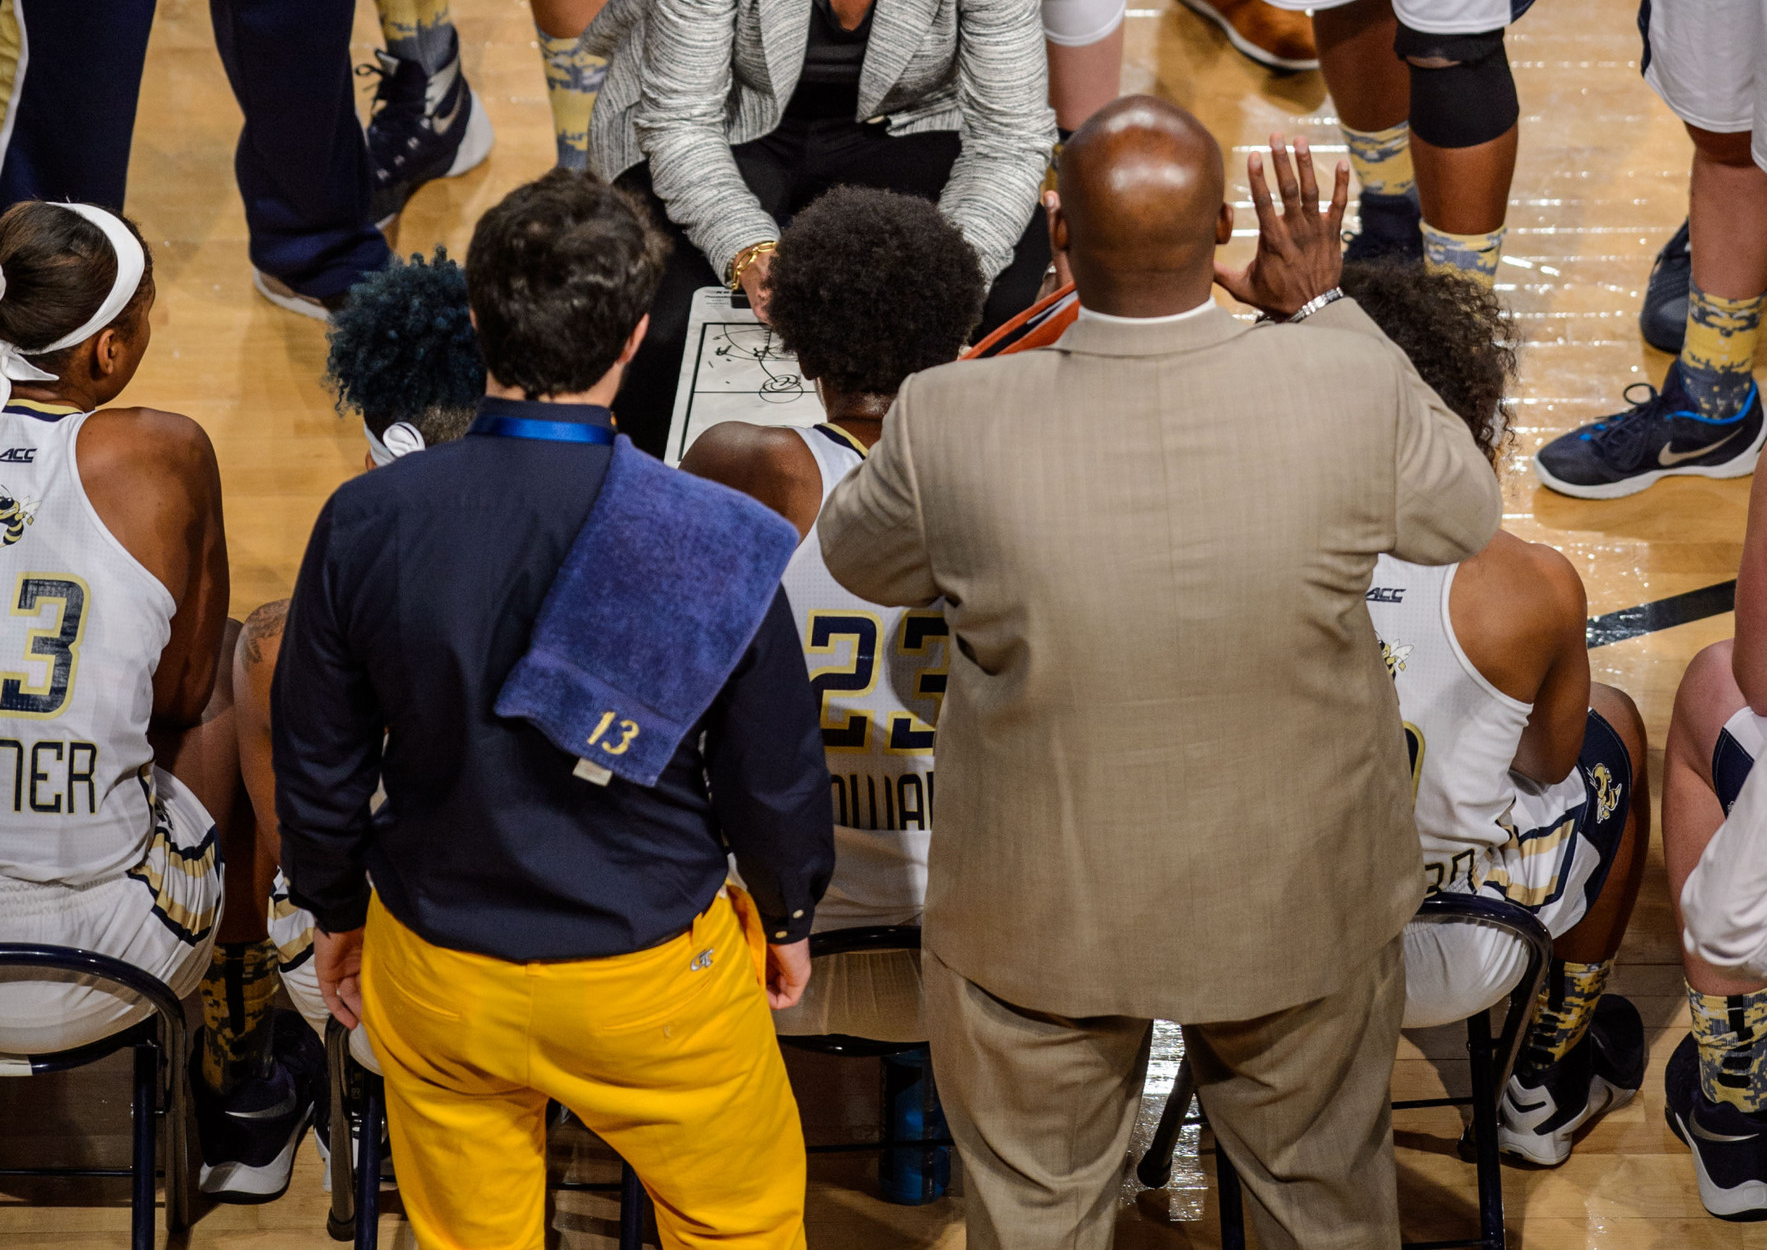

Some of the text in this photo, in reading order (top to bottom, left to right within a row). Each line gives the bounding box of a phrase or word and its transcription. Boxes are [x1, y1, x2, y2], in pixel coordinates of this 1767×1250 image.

[0, 447, 38, 463] ACC
[1365, 587, 1407, 603] ACC
[803, 608, 950, 757] 23
[587, 711, 640, 755] 13
